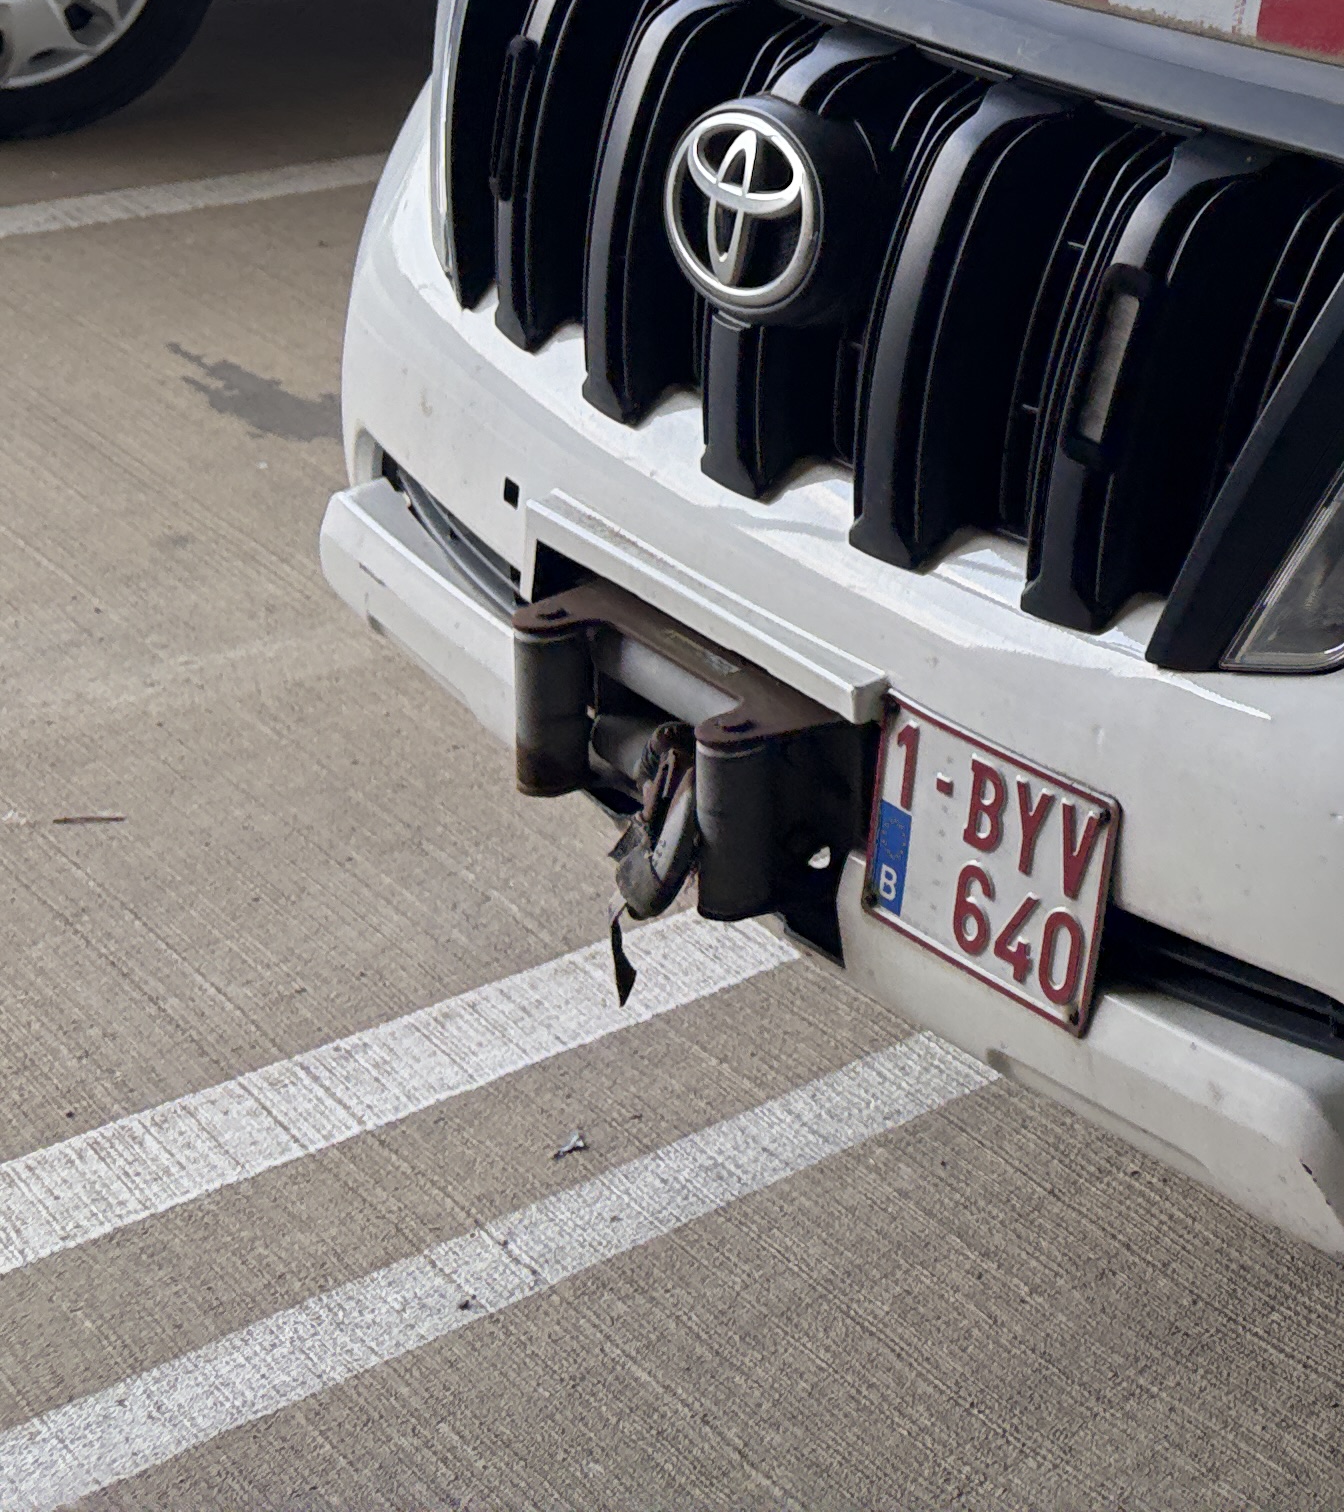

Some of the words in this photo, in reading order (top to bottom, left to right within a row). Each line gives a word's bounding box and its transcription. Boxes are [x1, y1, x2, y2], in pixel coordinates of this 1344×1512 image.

[879, 863, 898, 901] B
[897, 721, 1099, 899] 1-BYV
[953, 860, 1082, 1005] 640
